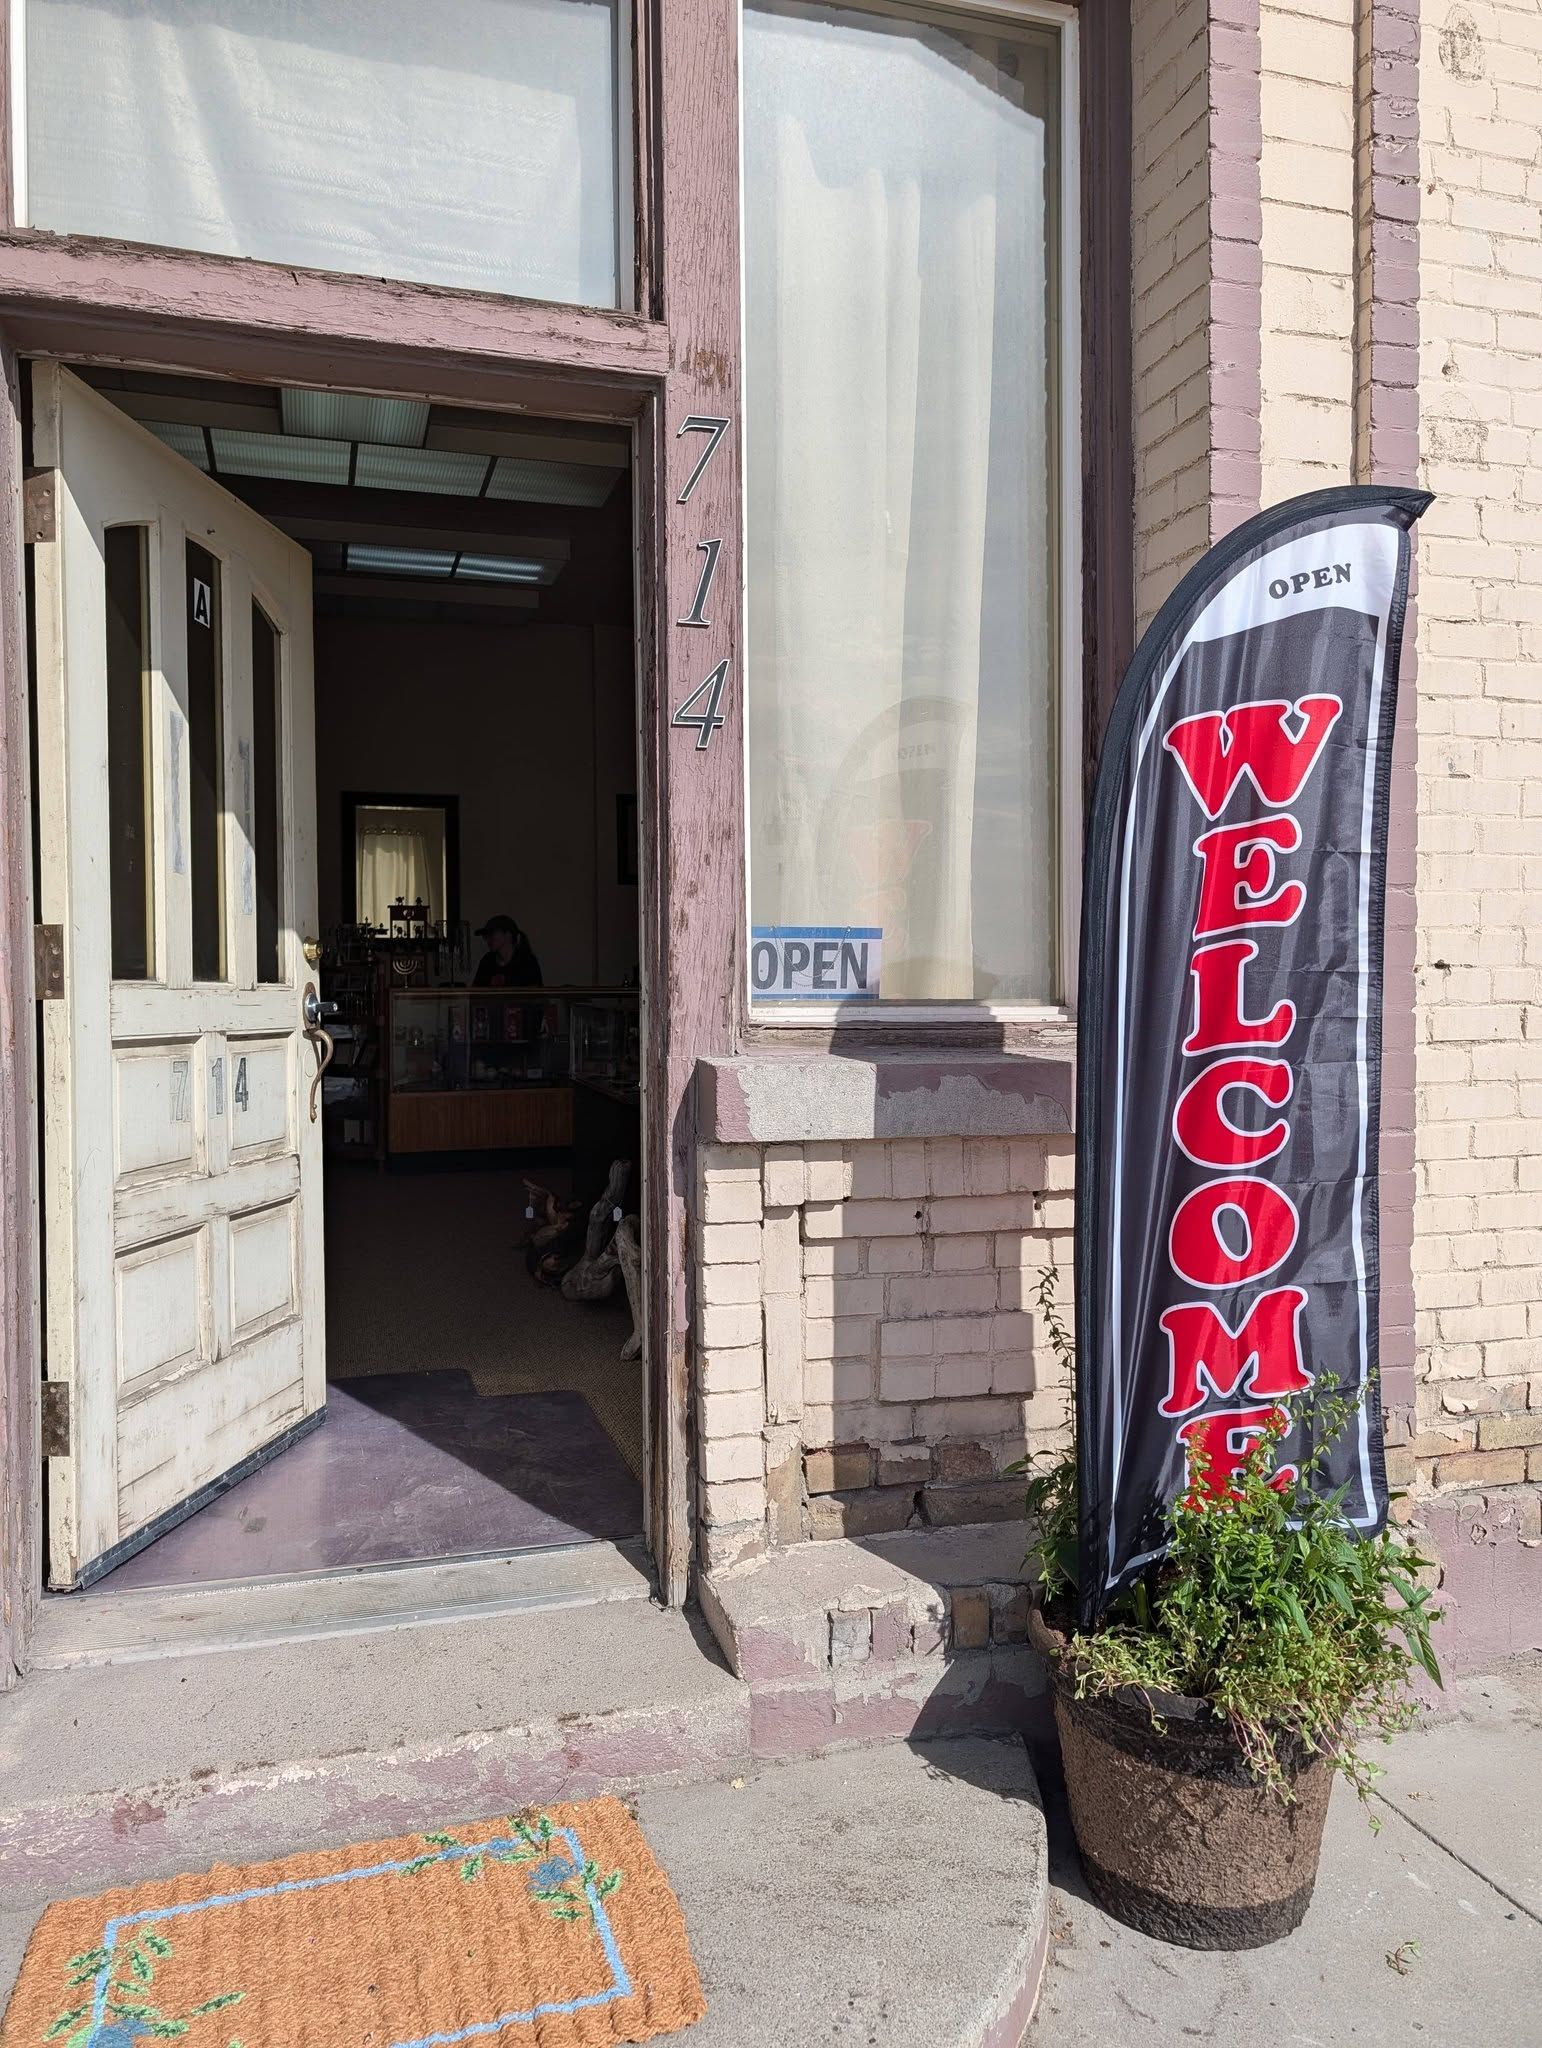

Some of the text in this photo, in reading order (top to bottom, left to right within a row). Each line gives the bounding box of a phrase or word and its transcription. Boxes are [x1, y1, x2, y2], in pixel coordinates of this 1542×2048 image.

[195, 582, 209, 626] A
[671, 415, 731, 751] 714
[1268, 562, 1353, 600] OPEN
[751, 941, 869, 990] OPEN
[172, 1057, 249, 1121] 714
[1157, 692, 1344, 1512] WELCOME
